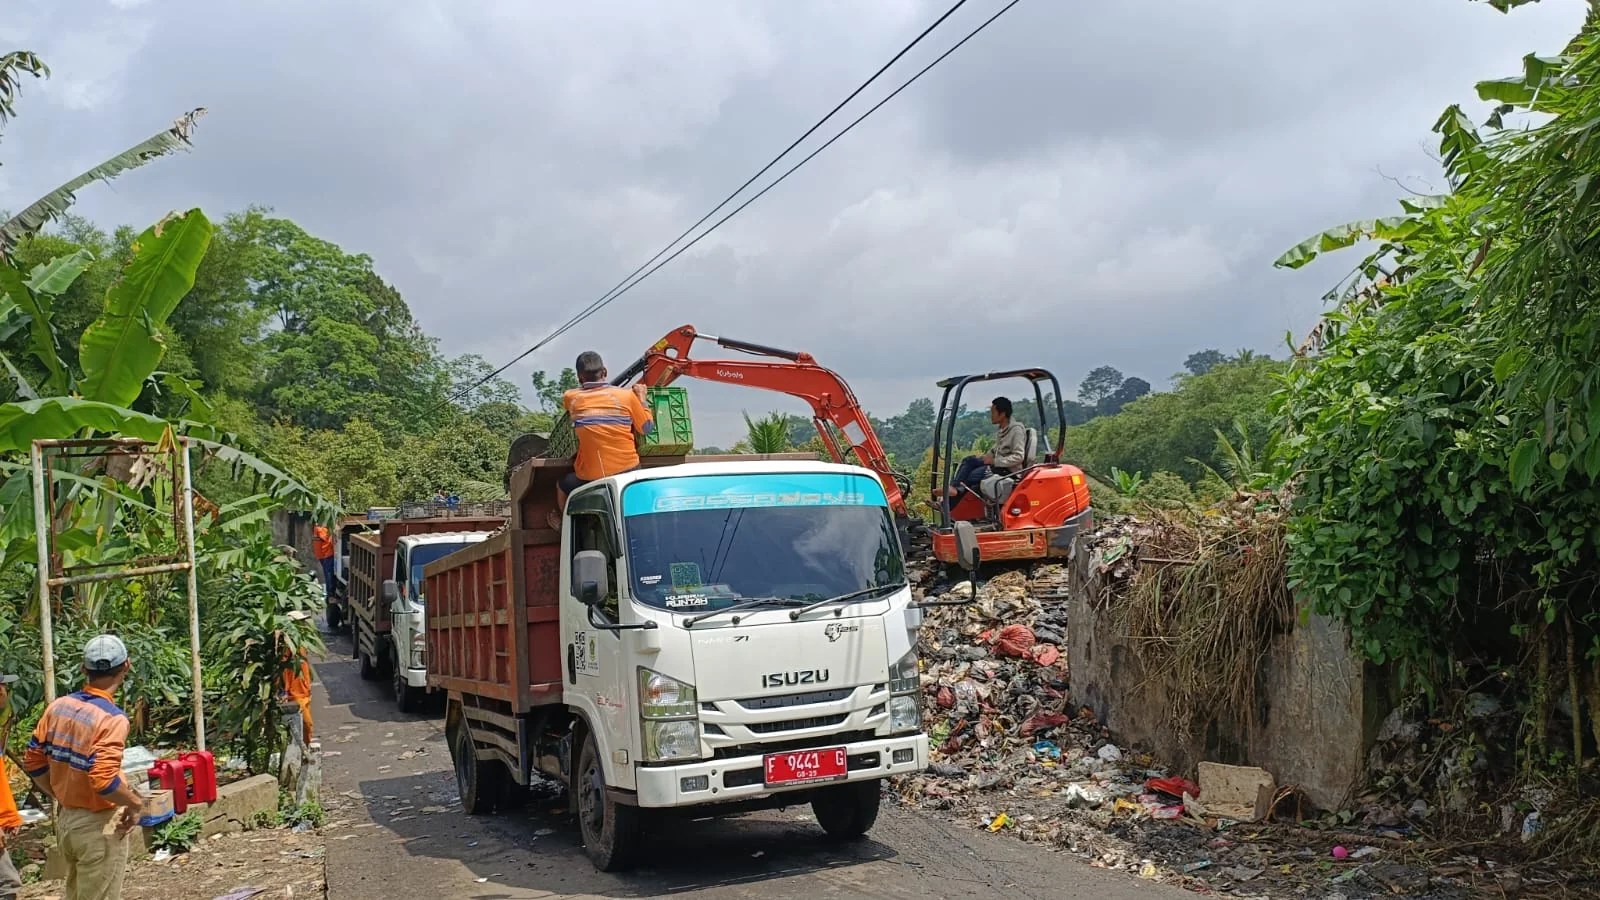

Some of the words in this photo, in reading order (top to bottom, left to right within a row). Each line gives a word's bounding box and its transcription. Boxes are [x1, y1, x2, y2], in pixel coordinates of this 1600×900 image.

[716, 369, 744, 379] Kubota
[665, 597, 708, 607] RUNTAH
[733, 635, 749, 643] 71
[762, 668, 829, 688] ISUZU
[768, 757, 776, 773] F
[788, 752, 820, 771] 9441
[835, 750, 844, 766] G
